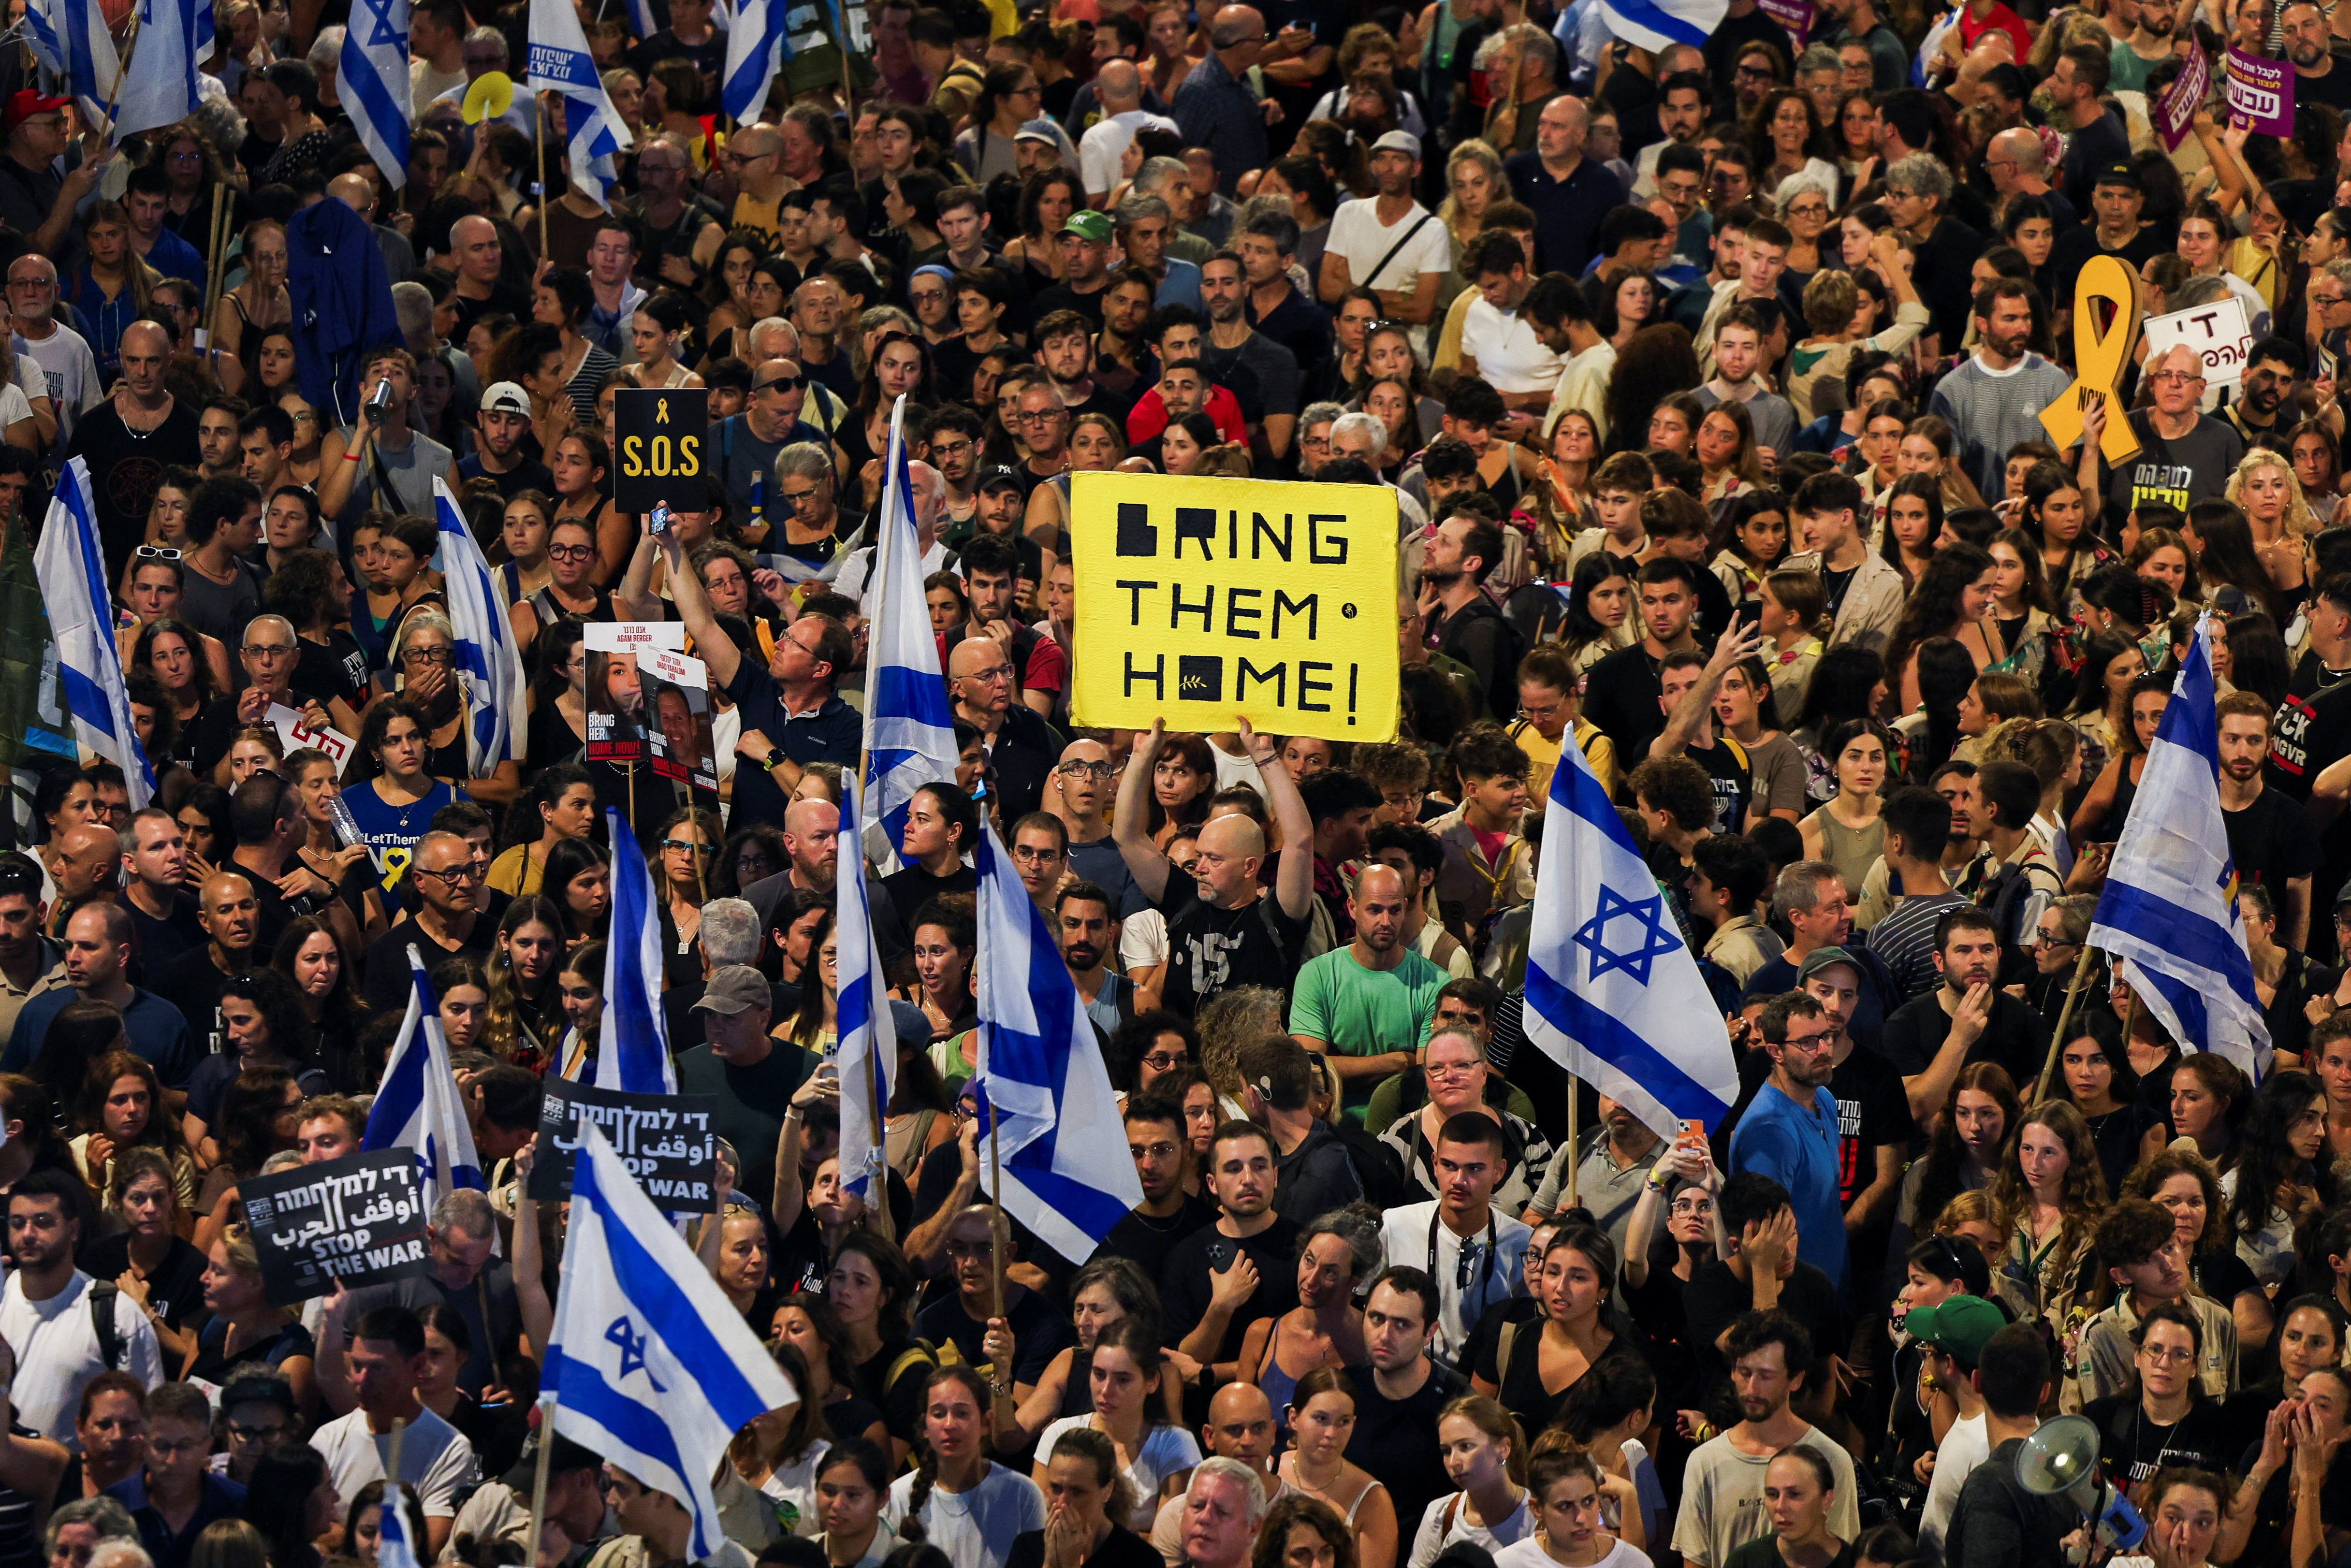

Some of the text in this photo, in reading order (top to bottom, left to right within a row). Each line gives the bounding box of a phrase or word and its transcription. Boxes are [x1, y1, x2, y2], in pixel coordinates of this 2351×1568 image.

[2228, 78, 2274, 114] עכשיו
[2176, 311, 2218, 338] די
[2201, 335, 2252, 367] להפ
[623, 435, 700, 477] S.O.S
[997, 465, 1012, 474] NY
[2134, 464, 2192, 489] למה הם
[2131, 485, 2189, 512] עדיין
[1116, 503, 1348, 565] BRING
[1116, 580, 1318, 640] THEM
[588, 714, 614, 727] BRING
[588, 727, 605, 740] HER
[588, 740, 641, 755] HOME NOW!
[649, 729, 667, 747] BRING
[650, 742, 663, 757] HIM
[569, 1101, 677, 1155] למלחמה
[683, 1113, 708, 1131] די
[642, 1133, 714, 1166] أوقف
[382, 1165, 409, 1185] די
[648, 1178, 709, 1200] WAR
[274, 1168, 377, 1230] למלחמה
[350, 1186, 420, 1225] أوقف
[272, 1204, 347, 1251] الحرب
[311, 1229, 371, 1259] STOP
[319, 1254, 365, 1278] THE
[365, 1239, 425, 1270] WAR
